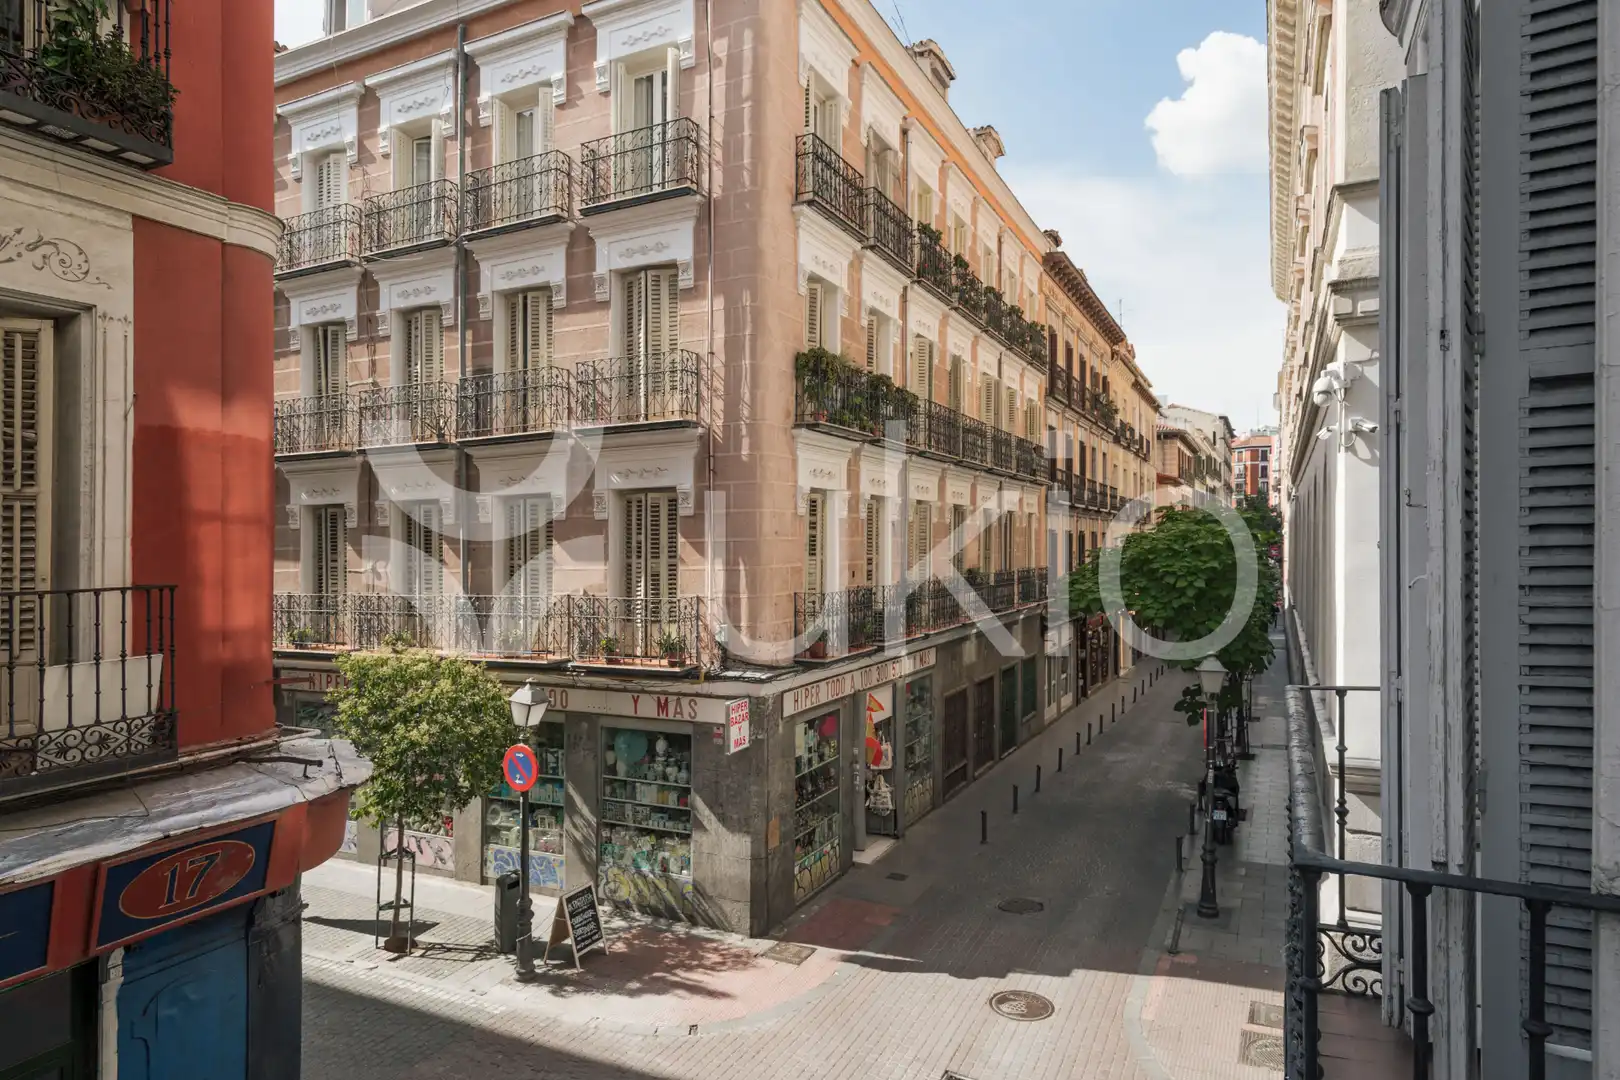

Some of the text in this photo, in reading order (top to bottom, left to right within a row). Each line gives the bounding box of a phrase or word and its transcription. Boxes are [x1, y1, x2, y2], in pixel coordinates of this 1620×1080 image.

[793, 684, 821, 711] HIPER
[825, 676, 846, 700] TODO
[849, 674, 856, 692] A
[860, 668, 873, 688] 100
[875, 663, 889, 682] 300
[919, 650, 931, 667] MAS
[631, 694, 640, 715] Y
[656, 695, 698, 720] MAS
[731, 700, 748, 714] HIPER
[729, 711, 749, 727] BAZAR
[737, 725, 743, 735] Y
[733, 735, 747, 749] MAS
[158, 850, 222, 909] 17
